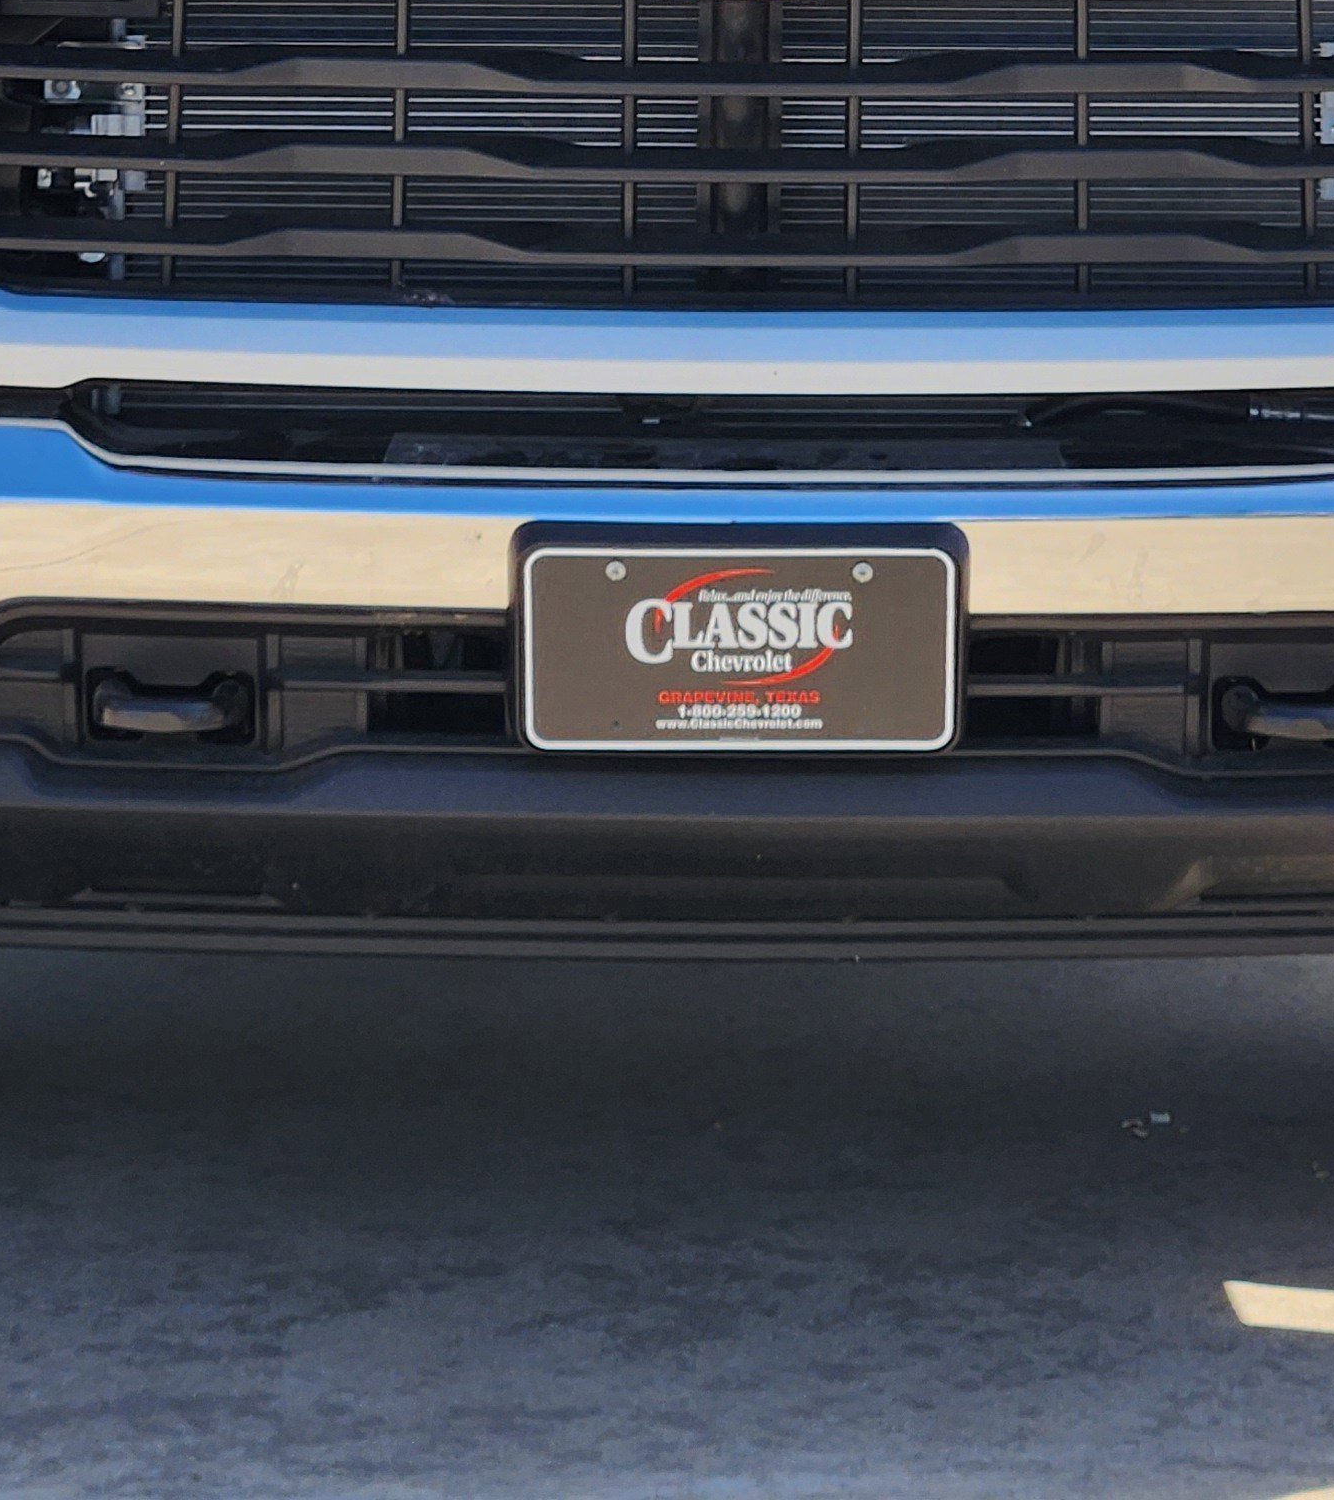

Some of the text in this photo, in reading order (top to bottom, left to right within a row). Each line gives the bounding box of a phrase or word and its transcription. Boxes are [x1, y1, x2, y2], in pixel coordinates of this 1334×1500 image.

[625, 599, 854, 664] CLASSIC
[691, 650, 793, 673] Chevrolet
[658, 690, 821, 705] GRAPEVINE, TEXAS
